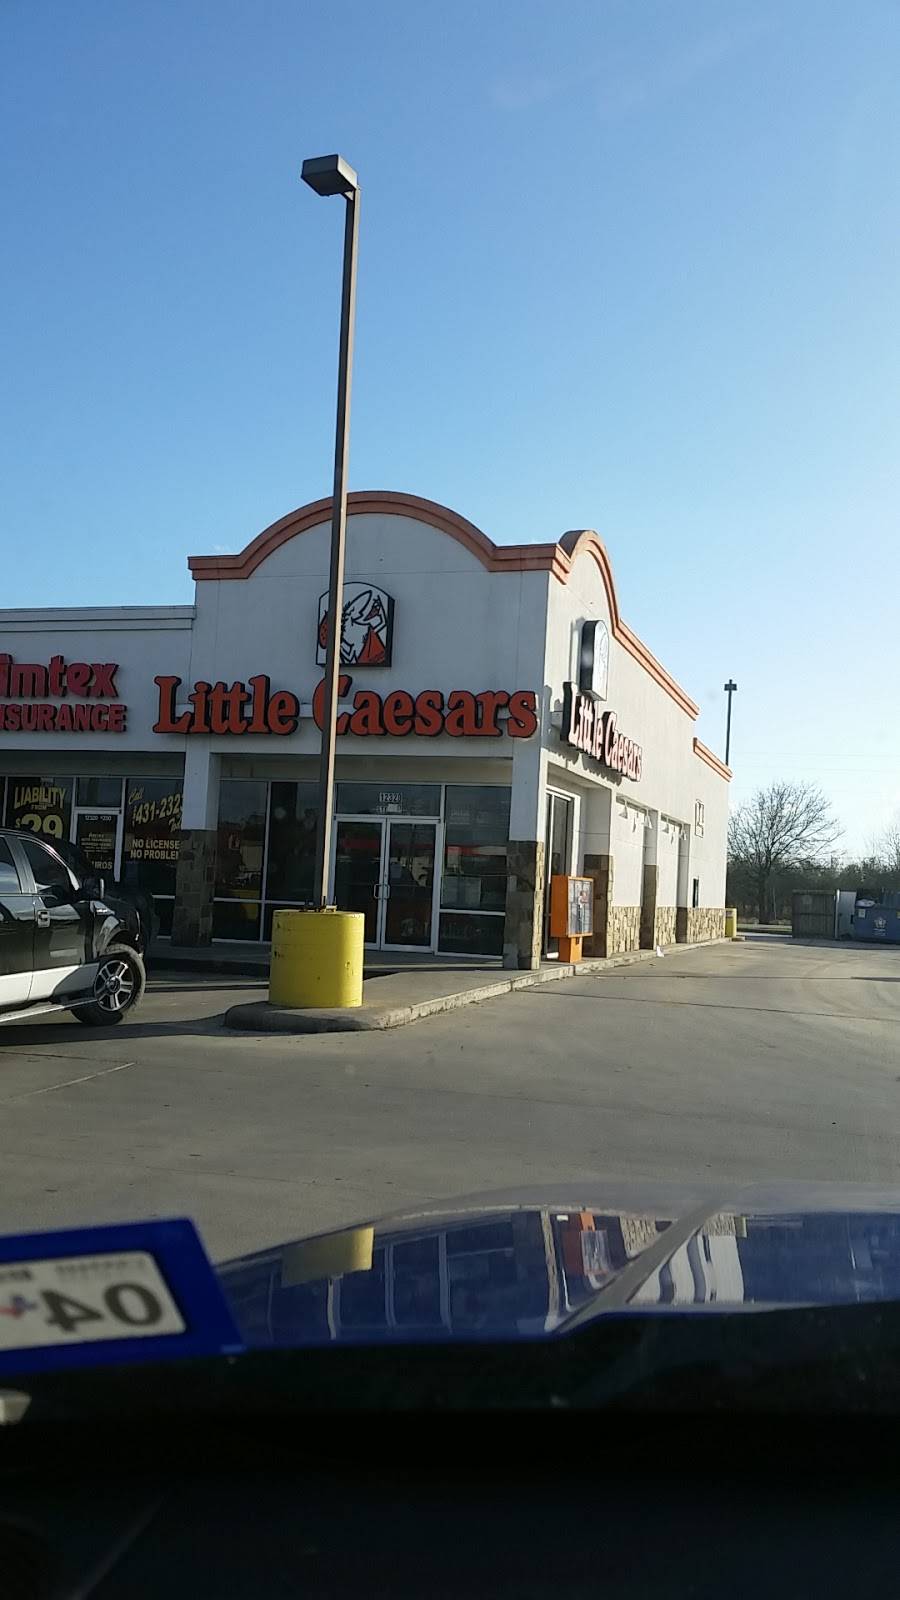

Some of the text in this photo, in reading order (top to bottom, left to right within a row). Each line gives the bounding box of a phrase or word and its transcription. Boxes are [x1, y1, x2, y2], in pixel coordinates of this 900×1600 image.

[153, 674, 538, 738] Little Caesars
[563, 682, 642, 782] Little Caesars
[14, 786, 66, 809] LIABILITY
[130, 849, 143, 859] NO
[132, 839, 180, 849] NO LICENSE
